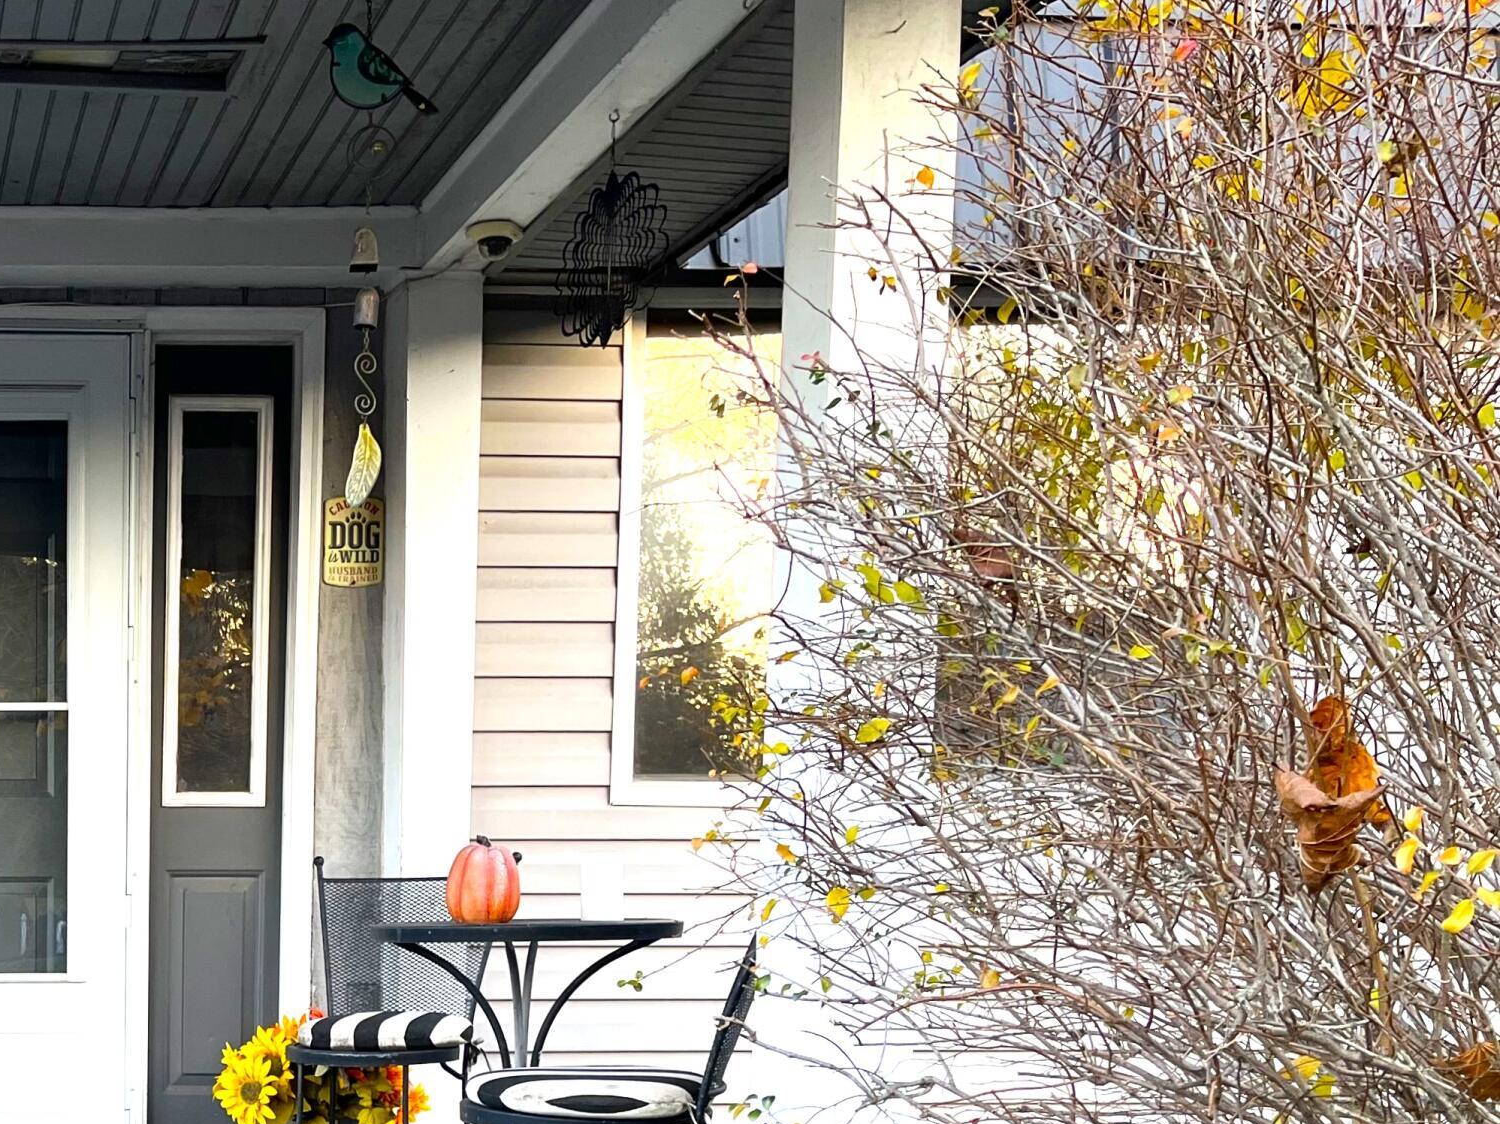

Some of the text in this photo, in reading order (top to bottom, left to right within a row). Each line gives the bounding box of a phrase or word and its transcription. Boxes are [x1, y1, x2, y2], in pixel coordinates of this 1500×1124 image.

[329, 500, 380, 516] CAUON
[328, 521, 381, 549] DOG
[328, 550, 380, 563] is WILD
[328, 566, 378, 576] HUSBAND
